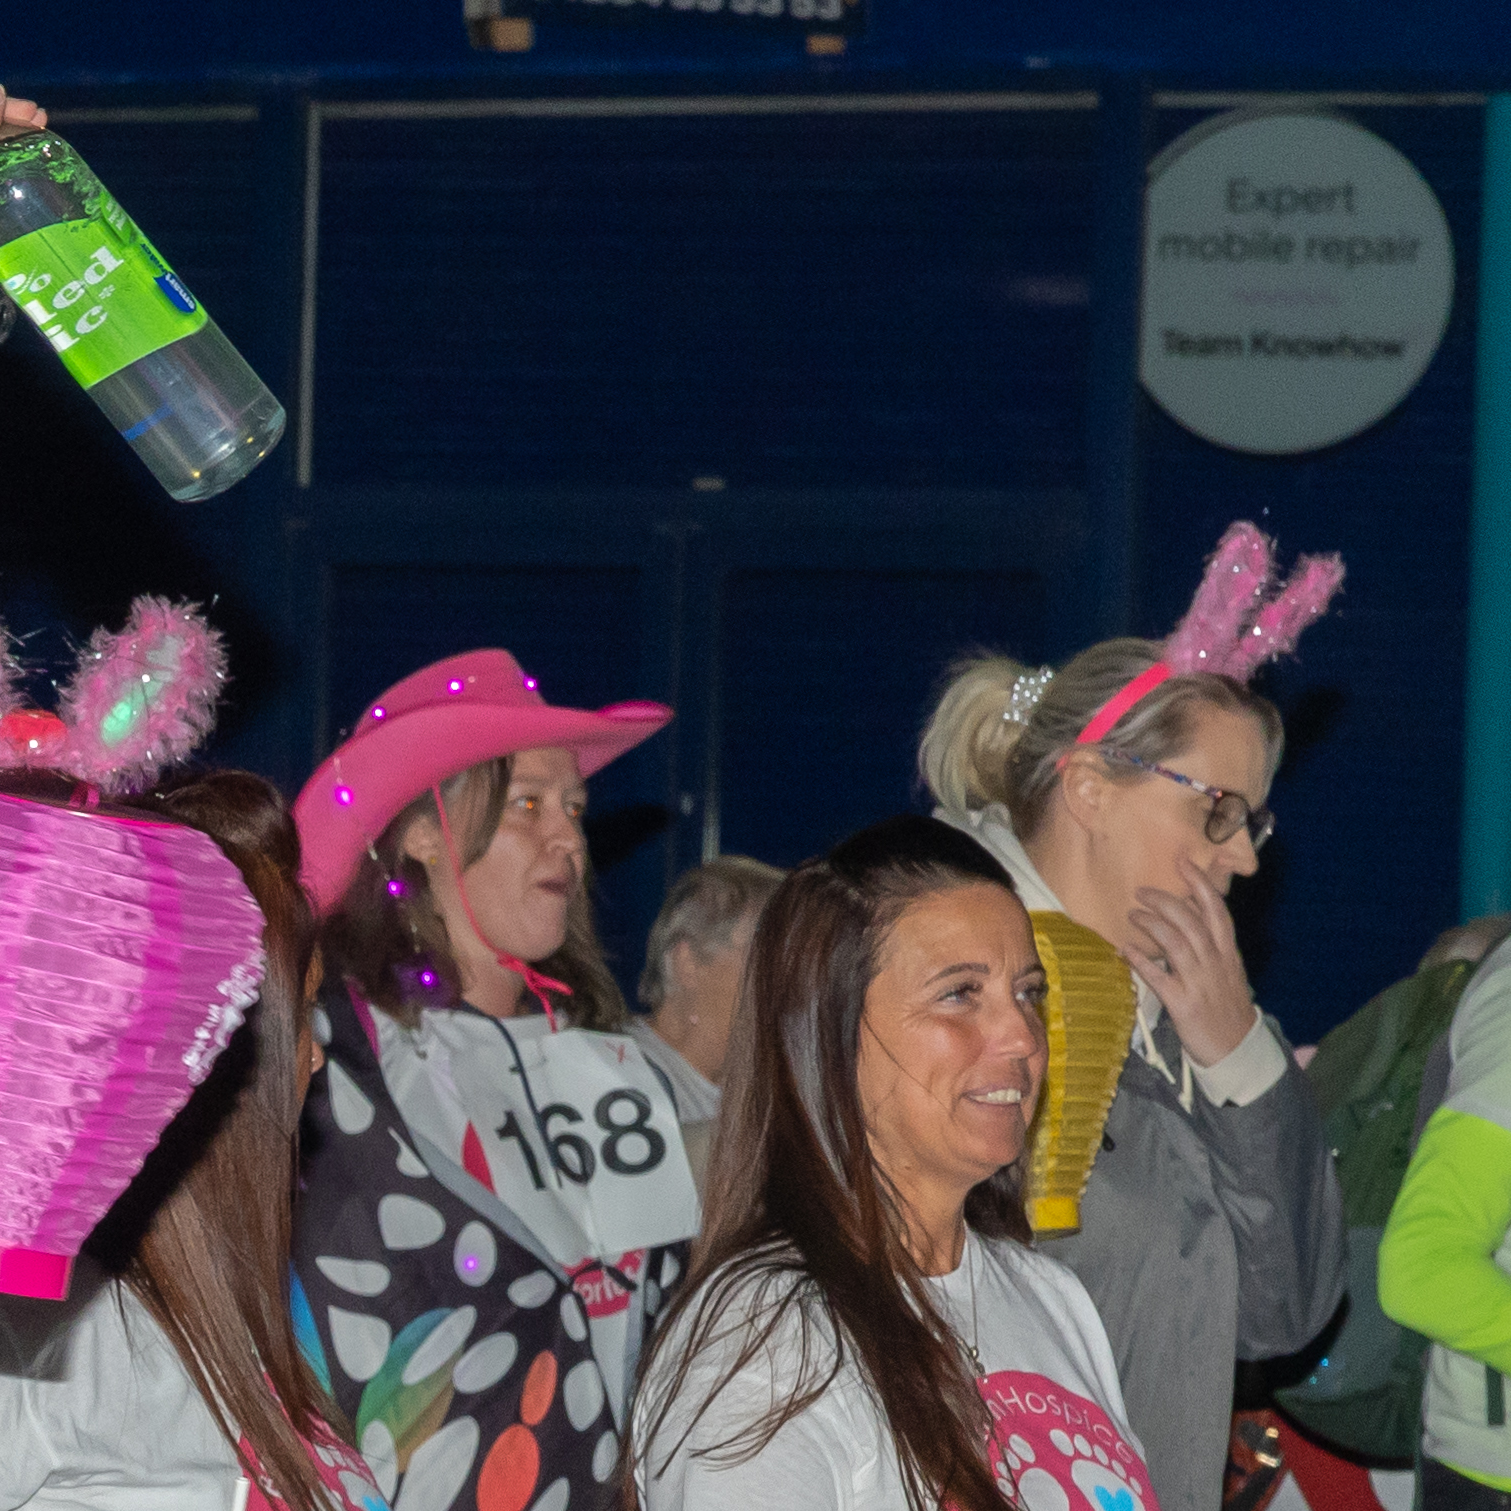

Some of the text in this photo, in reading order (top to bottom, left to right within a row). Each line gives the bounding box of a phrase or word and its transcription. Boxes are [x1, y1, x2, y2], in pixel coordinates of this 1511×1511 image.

[1227, 177, 1355, 216] Expert
[1156, 231, 1420, 269] mobile repair
[1162, 329, 1406, 361] Team Knowhow
[494, 1086, 667, 1192] 168
[995, 1385, 1135, 1465] Hospice
